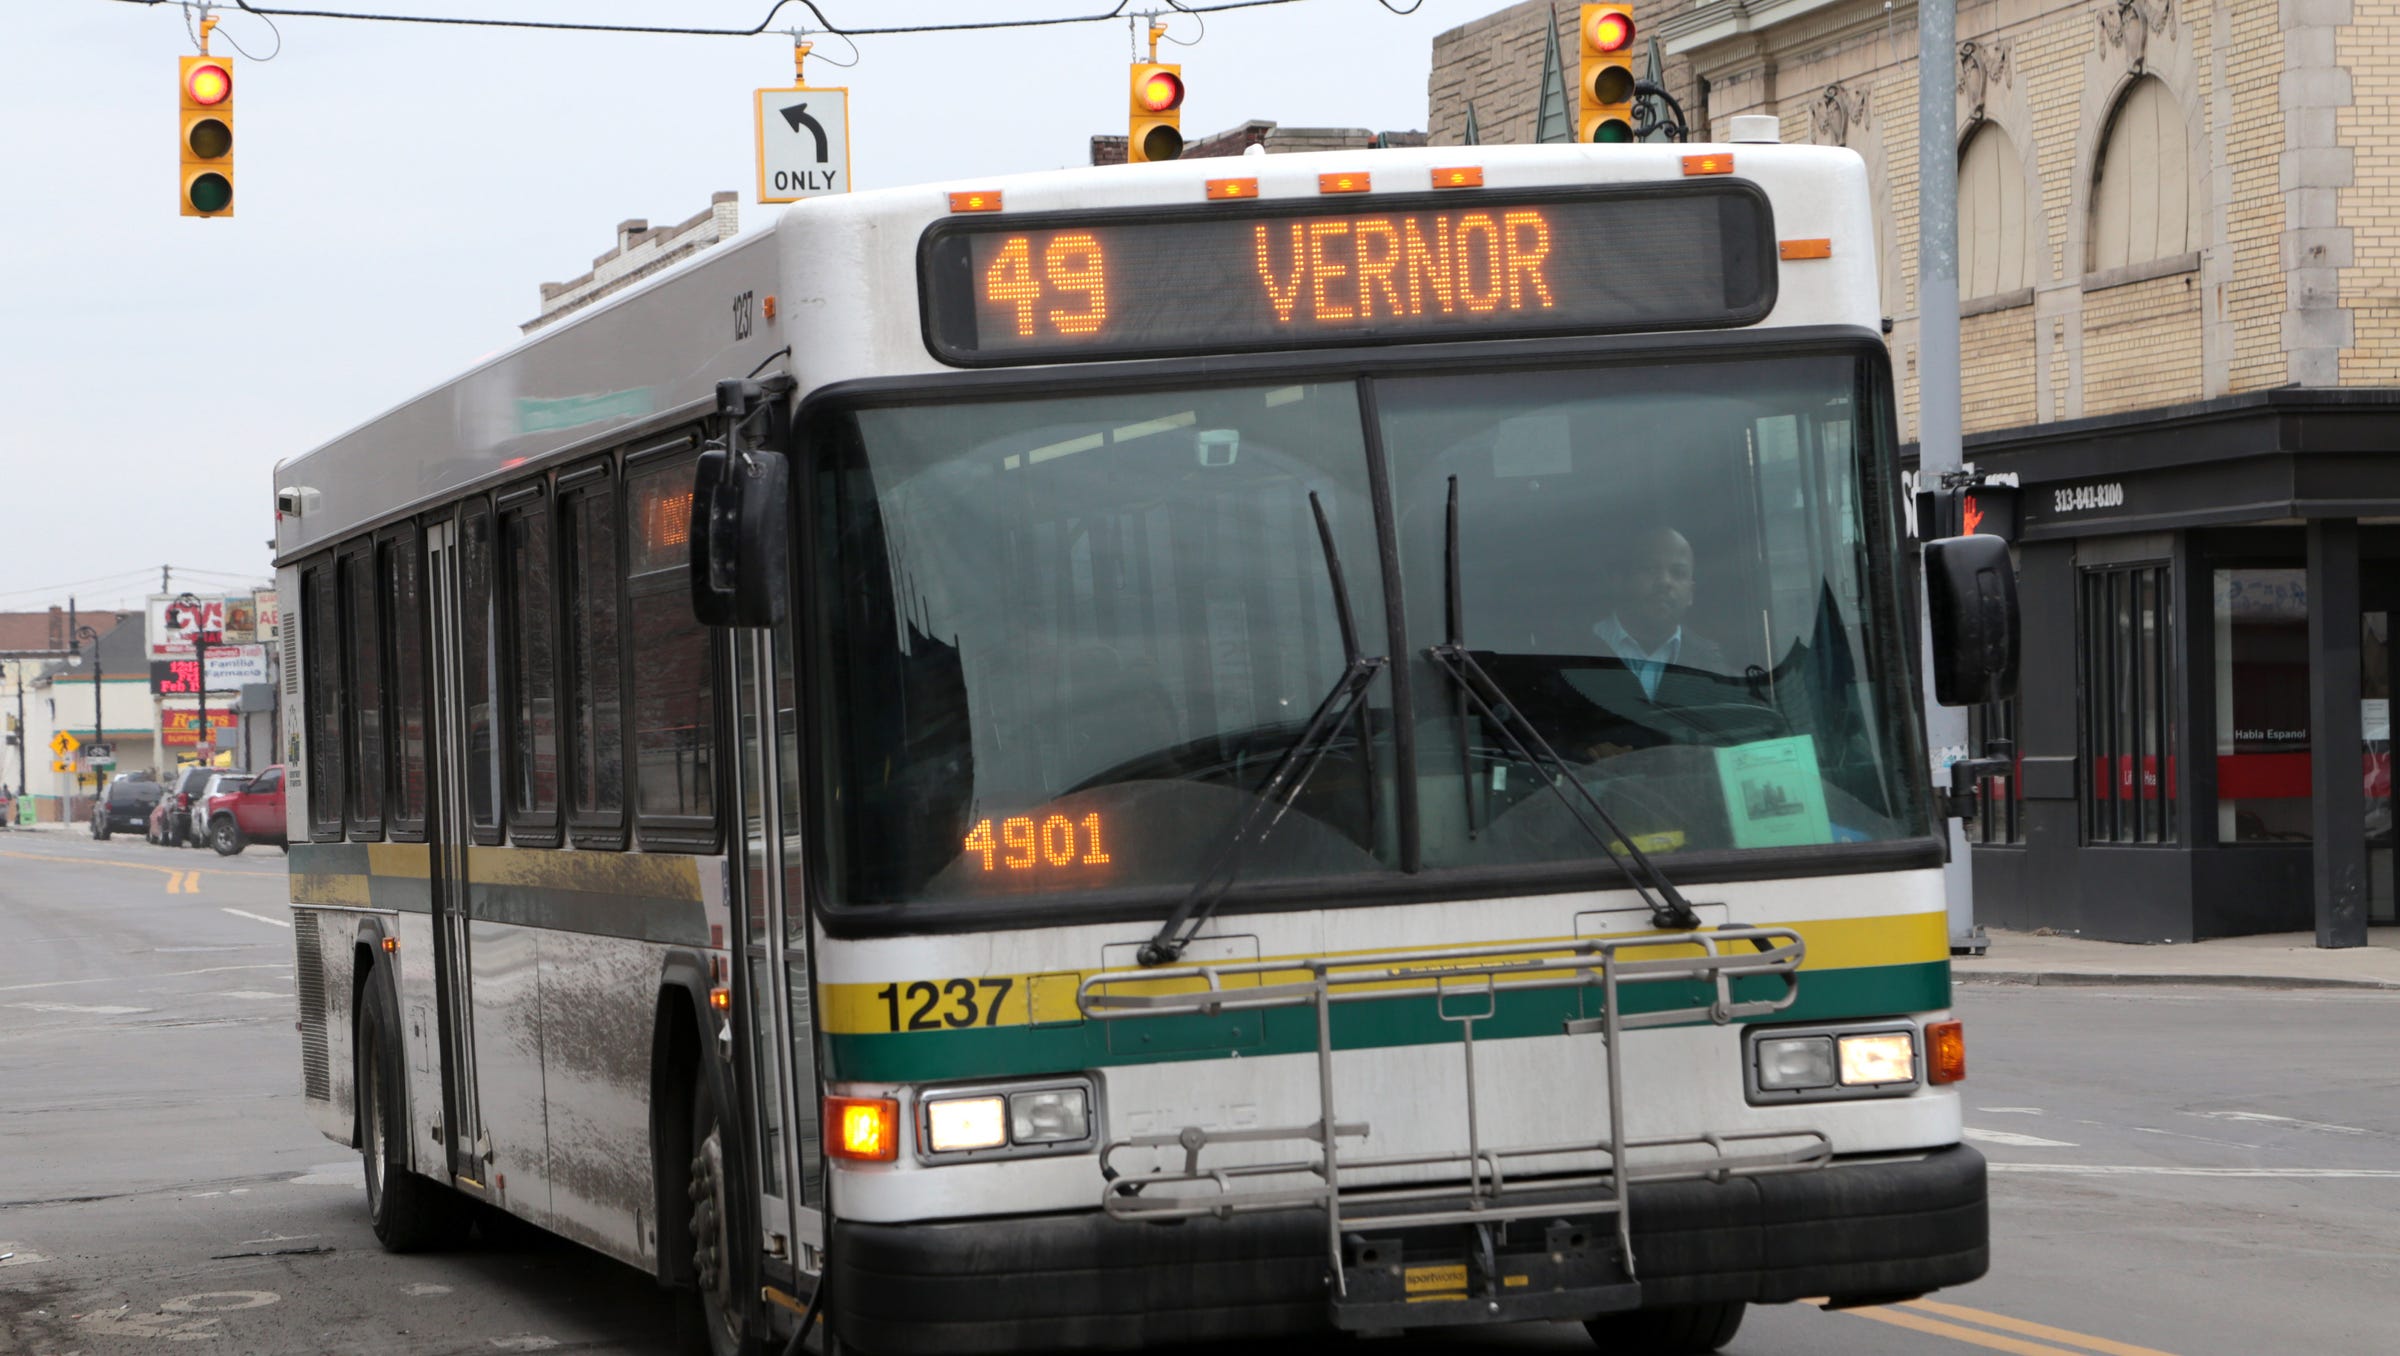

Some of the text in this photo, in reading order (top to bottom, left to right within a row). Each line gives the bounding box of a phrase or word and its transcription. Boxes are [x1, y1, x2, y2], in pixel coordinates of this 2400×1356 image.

[775, 170, 836, 191] ONLY
[987, 211, 1553, 337] 49 VERNOR
[733, 290, 753, 340] 1237
[2055, 482, 2124, 513] 313-841-8100
[165, 602, 222, 630] CVS
[2235, 729, 2306, 741] Habla Espanol
[965, 812, 1110, 871] 4901
[878, 978, 1013, 1032] 1237
[1407, 1271, 1466, 1285] sportworks
